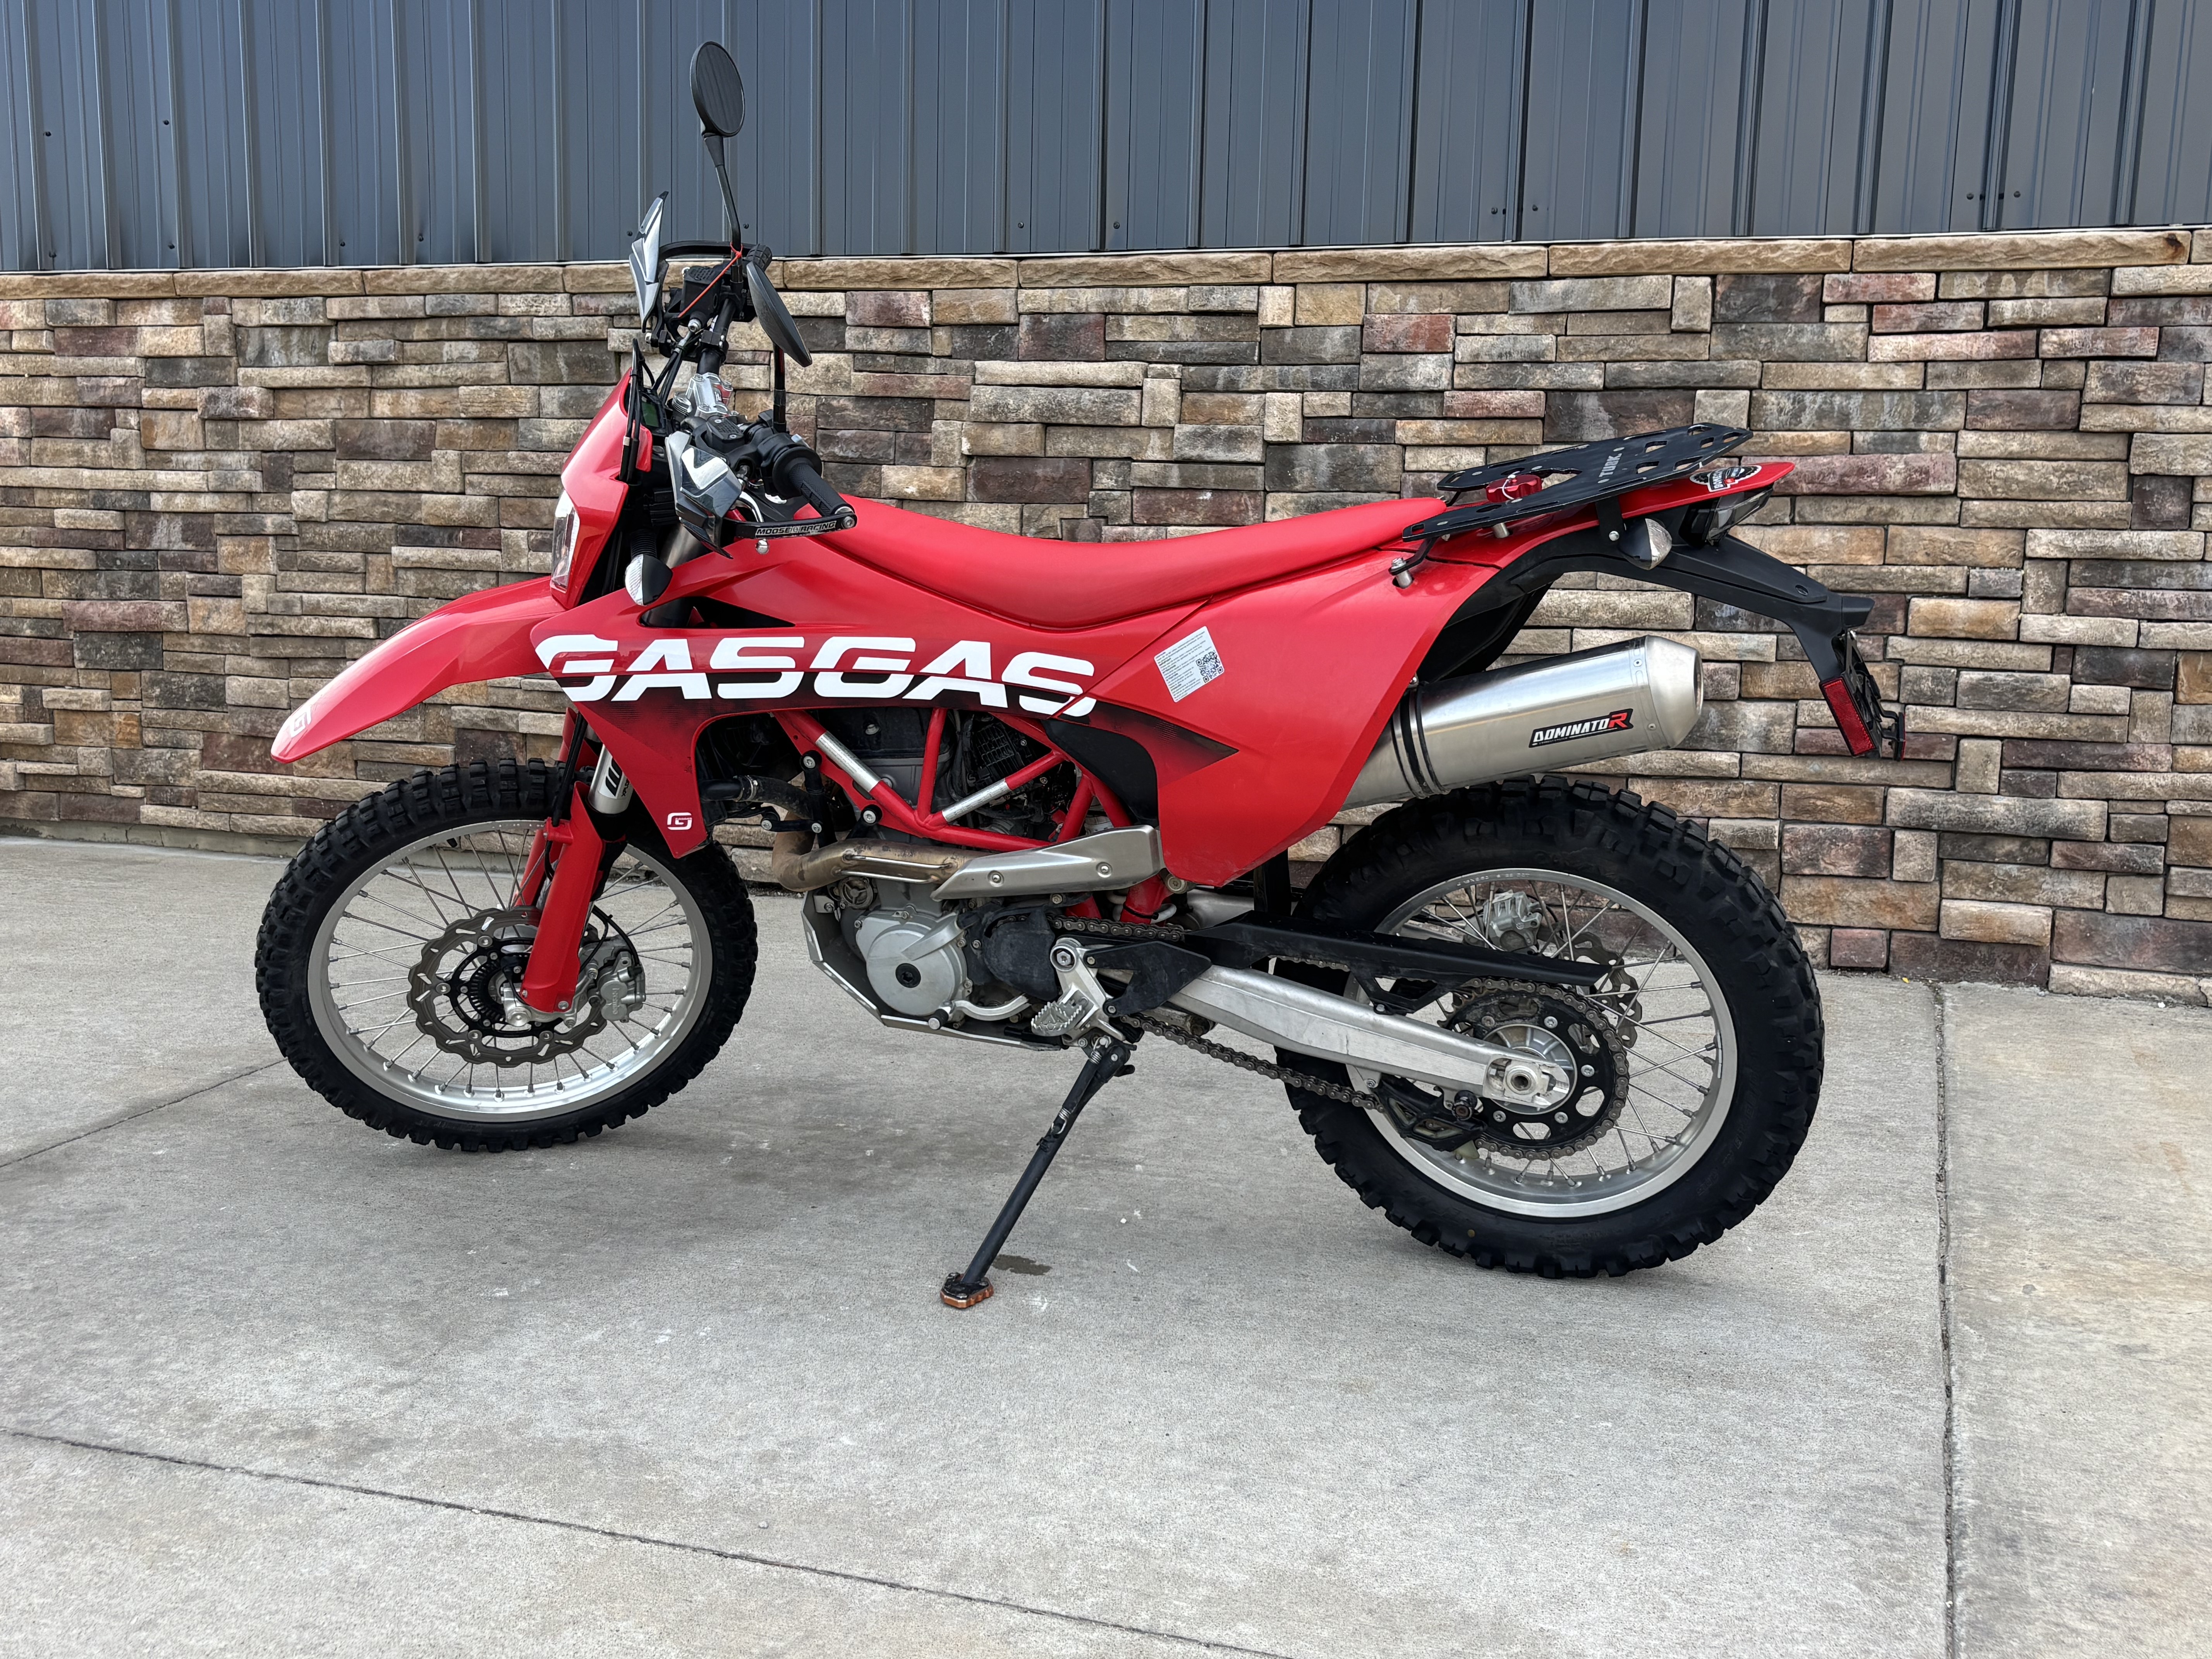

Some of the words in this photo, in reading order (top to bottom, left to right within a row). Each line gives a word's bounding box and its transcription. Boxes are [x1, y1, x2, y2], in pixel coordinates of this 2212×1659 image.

[800, 522, 836, 532] RACING
[535, 634, 1097, 717] GASGAS
[1533, 712, 1628, 743] DOMINATOR
